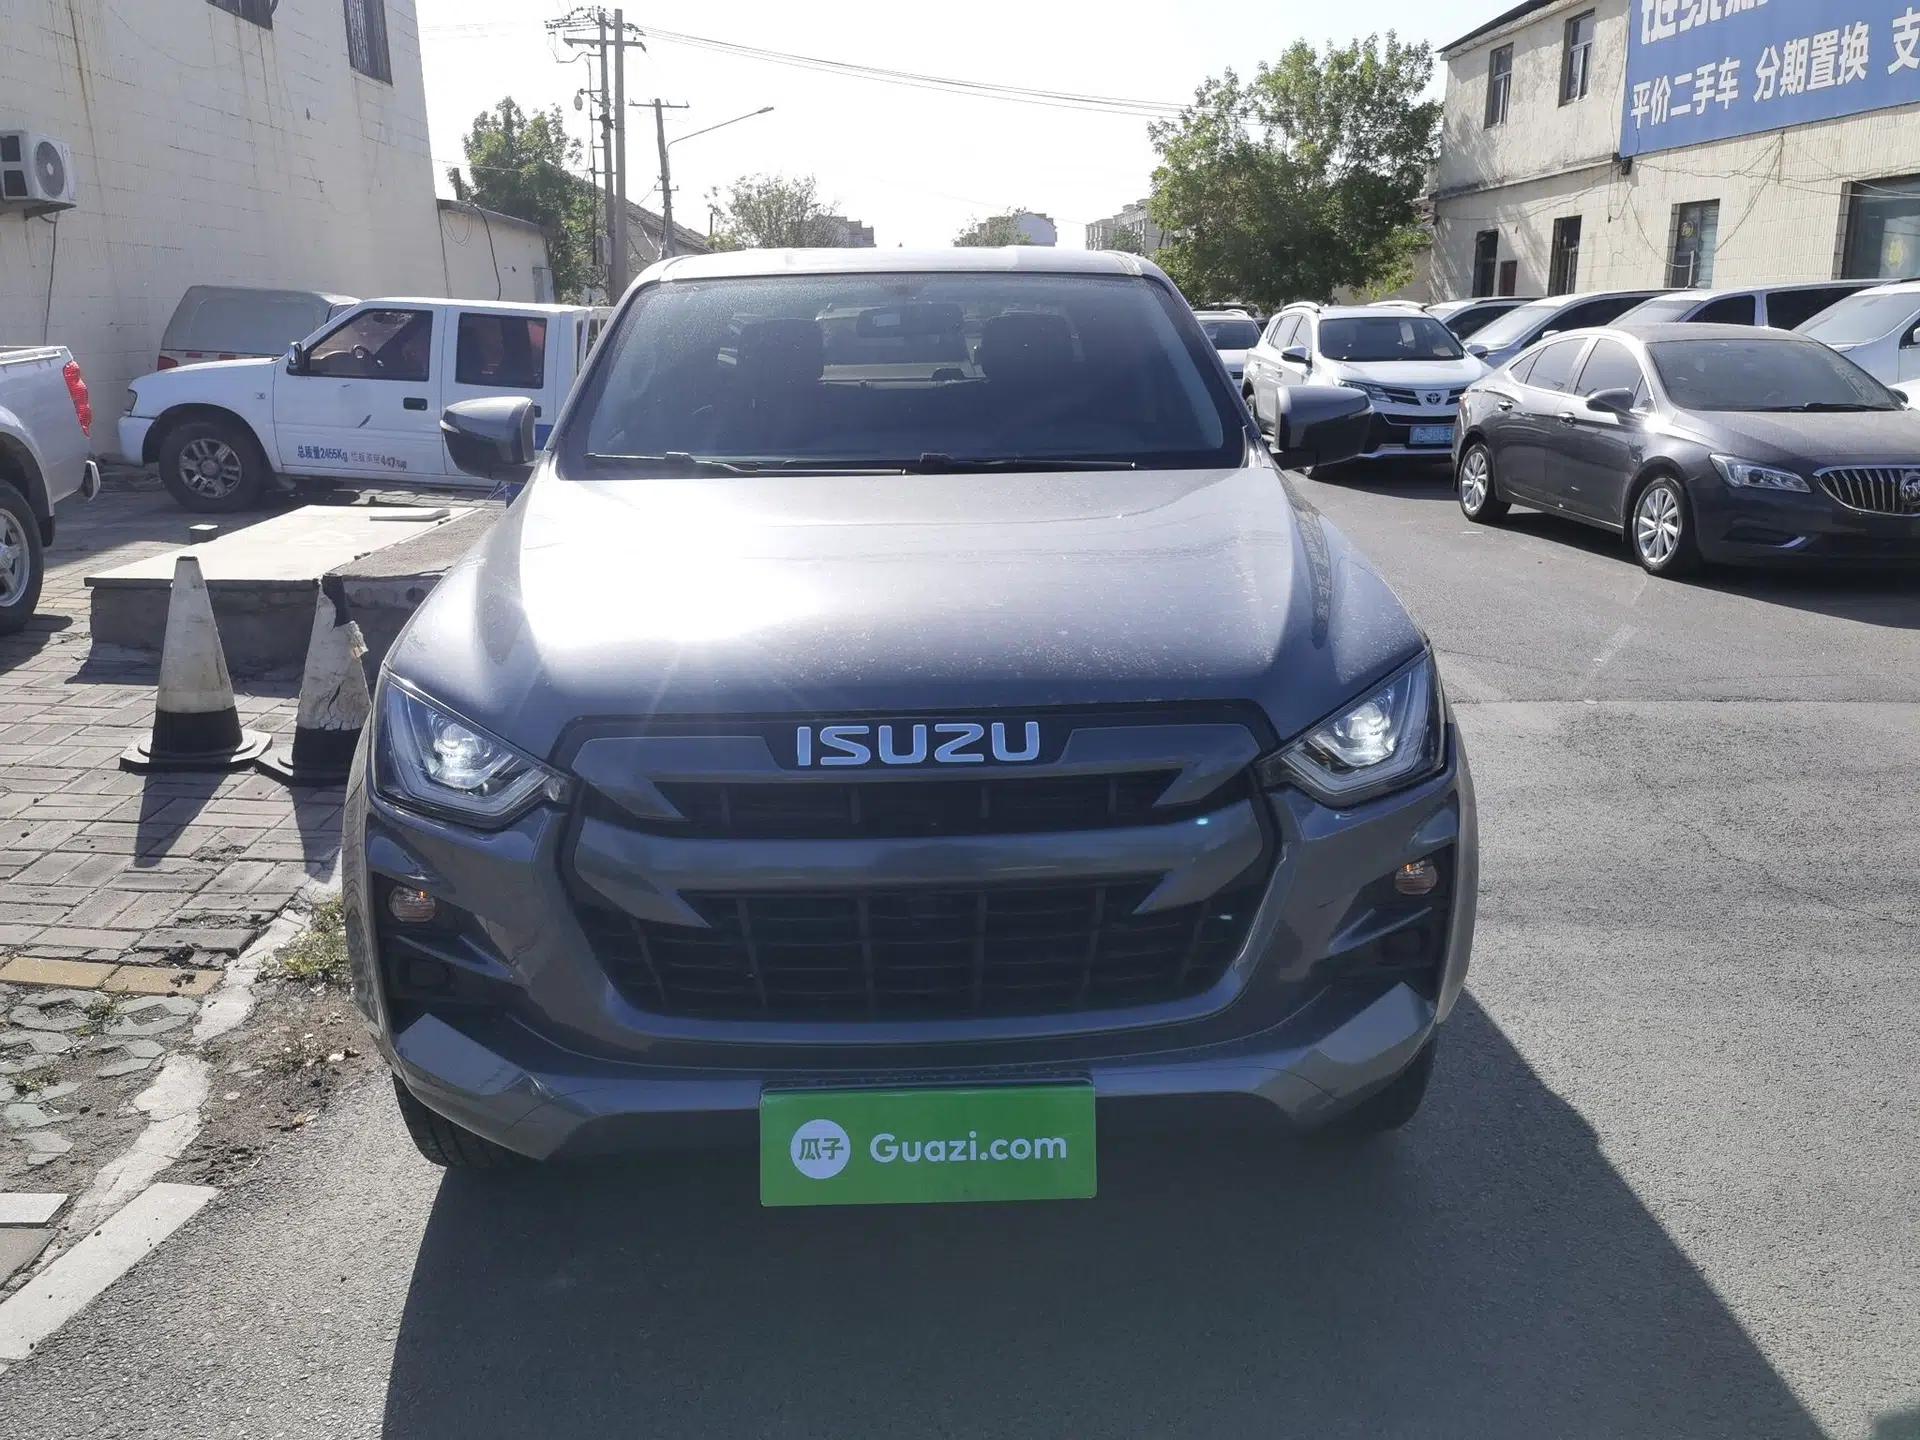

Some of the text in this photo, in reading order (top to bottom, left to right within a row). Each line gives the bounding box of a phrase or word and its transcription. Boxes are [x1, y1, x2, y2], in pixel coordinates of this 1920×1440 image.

[1630, 57, 1741, 129] 平价二手车
[1753, 21, 1870, 103] 分期置换
[797, 721, 1040, 766] ISUZU
[799, 1137, 844, 1161] 瓜子
[870, 1131, 1067, 1163] Guazi.com
